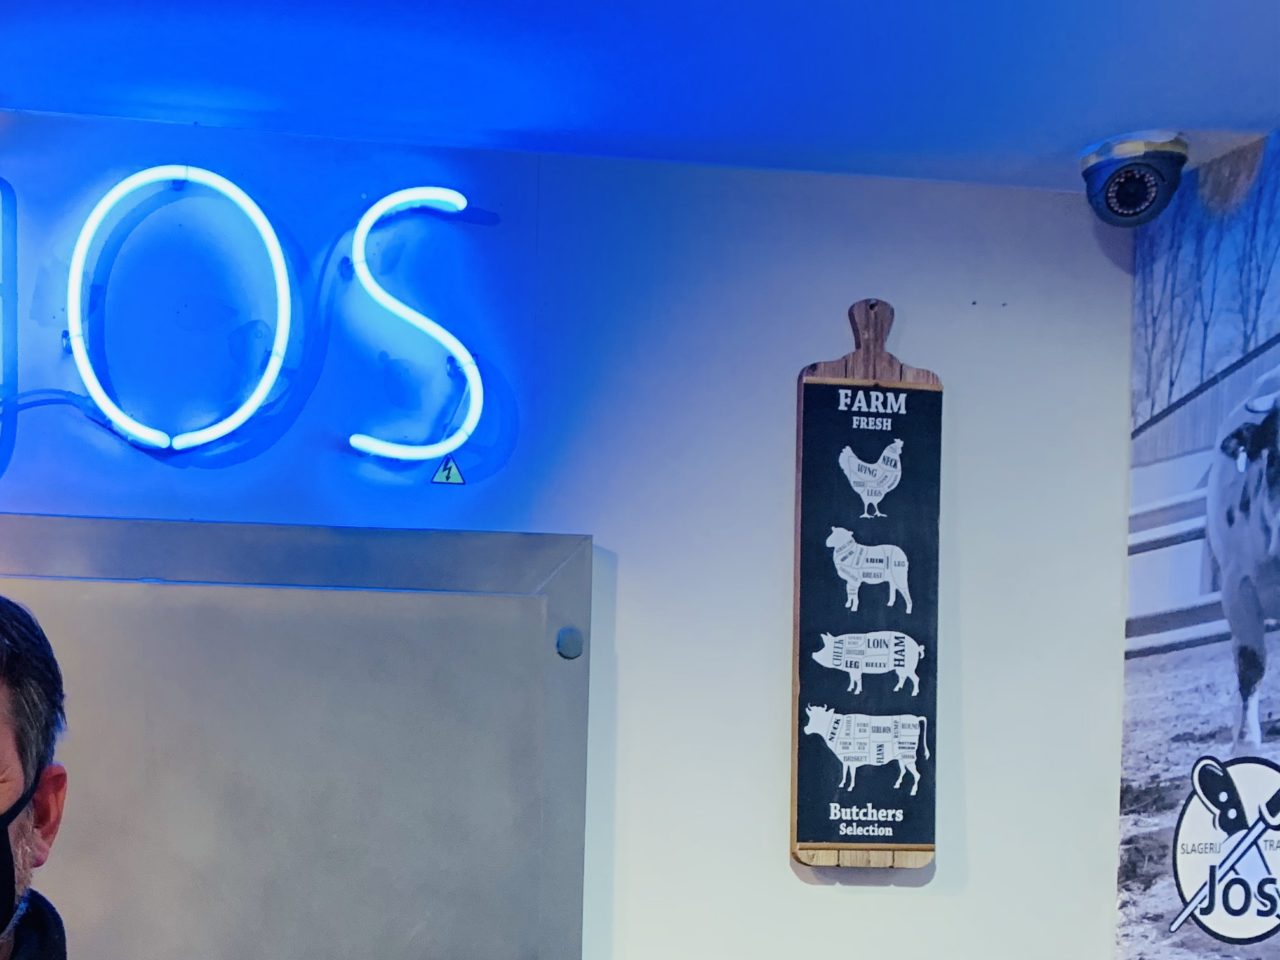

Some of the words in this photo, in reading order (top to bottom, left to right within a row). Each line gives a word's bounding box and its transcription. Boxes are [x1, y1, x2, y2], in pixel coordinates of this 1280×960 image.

[838, 389, 907, 414] FARM
[852, 416, 892, 430] FRESH
[867, 638, 889, 649] LOIN
[893, 635, 906, 668] HAM
[845, 660, 860, 669] LEG
[829, 803, 904, 822] Butchers
[839, 822, 893, 836] Selection
[1200, 865, 1278, 917] JOS
